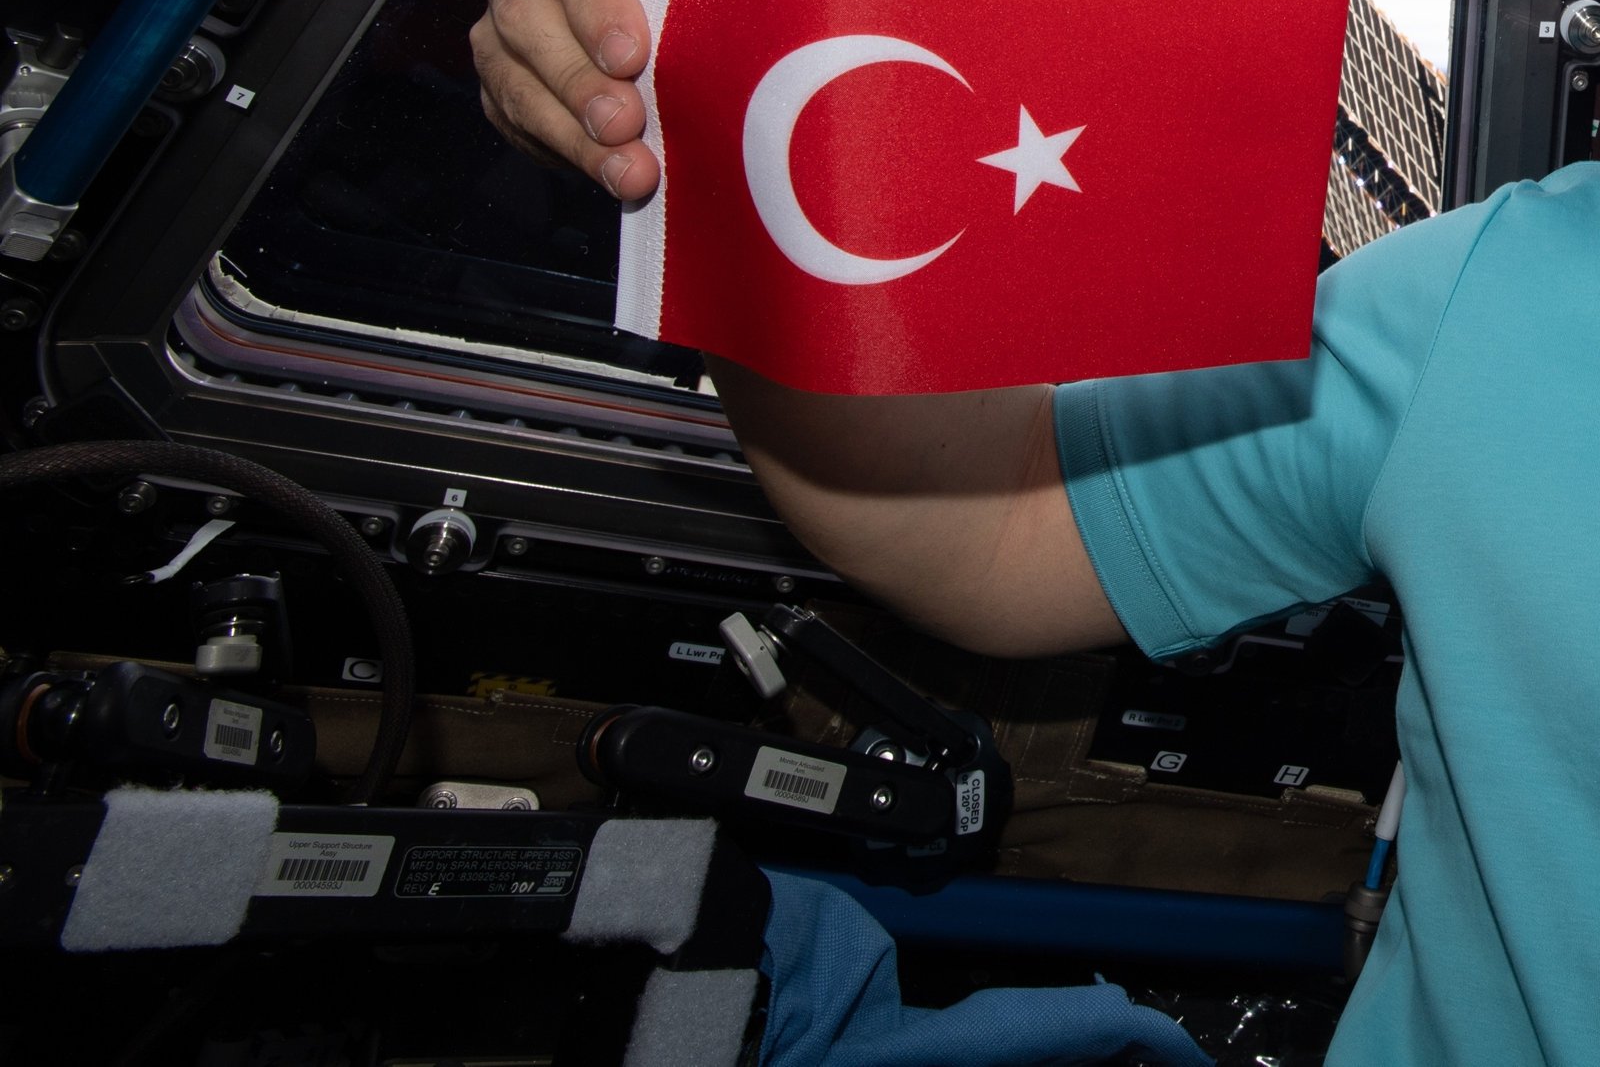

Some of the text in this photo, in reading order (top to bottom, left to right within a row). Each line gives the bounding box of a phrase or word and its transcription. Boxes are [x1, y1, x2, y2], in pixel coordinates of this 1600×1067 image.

[236, 92, 245, 101] 7
[676, 646, 683, 655] L
[686, 647, 706, 659] Lwr
[350, 660, 378, 680] C
[1128, 713, 1136, 721] R
[1138, 714, 1155, 724] Lwr
[1157, 753, 1181, 769] G
[961, 774, 969, 785] or
[1278, 766, 1304, 783] H
[970, 778, 980, 824] CLOSED
[960, 816, 969, 832] OP
[288, 840, 373, 850] Upper Support Structure
[411, 850, 577, 860] SUPPORT STRUCTURE UPPER ASSY
[435, 861, 449, 871] by
[450, 861, 479, 870] SPAR
[480, 861, 544, 870] AEROSPACE
[406, 872, 435, 882] ASSY
[542, 877, 567, 886] SPAR
[427, 882, 442, 896] E
